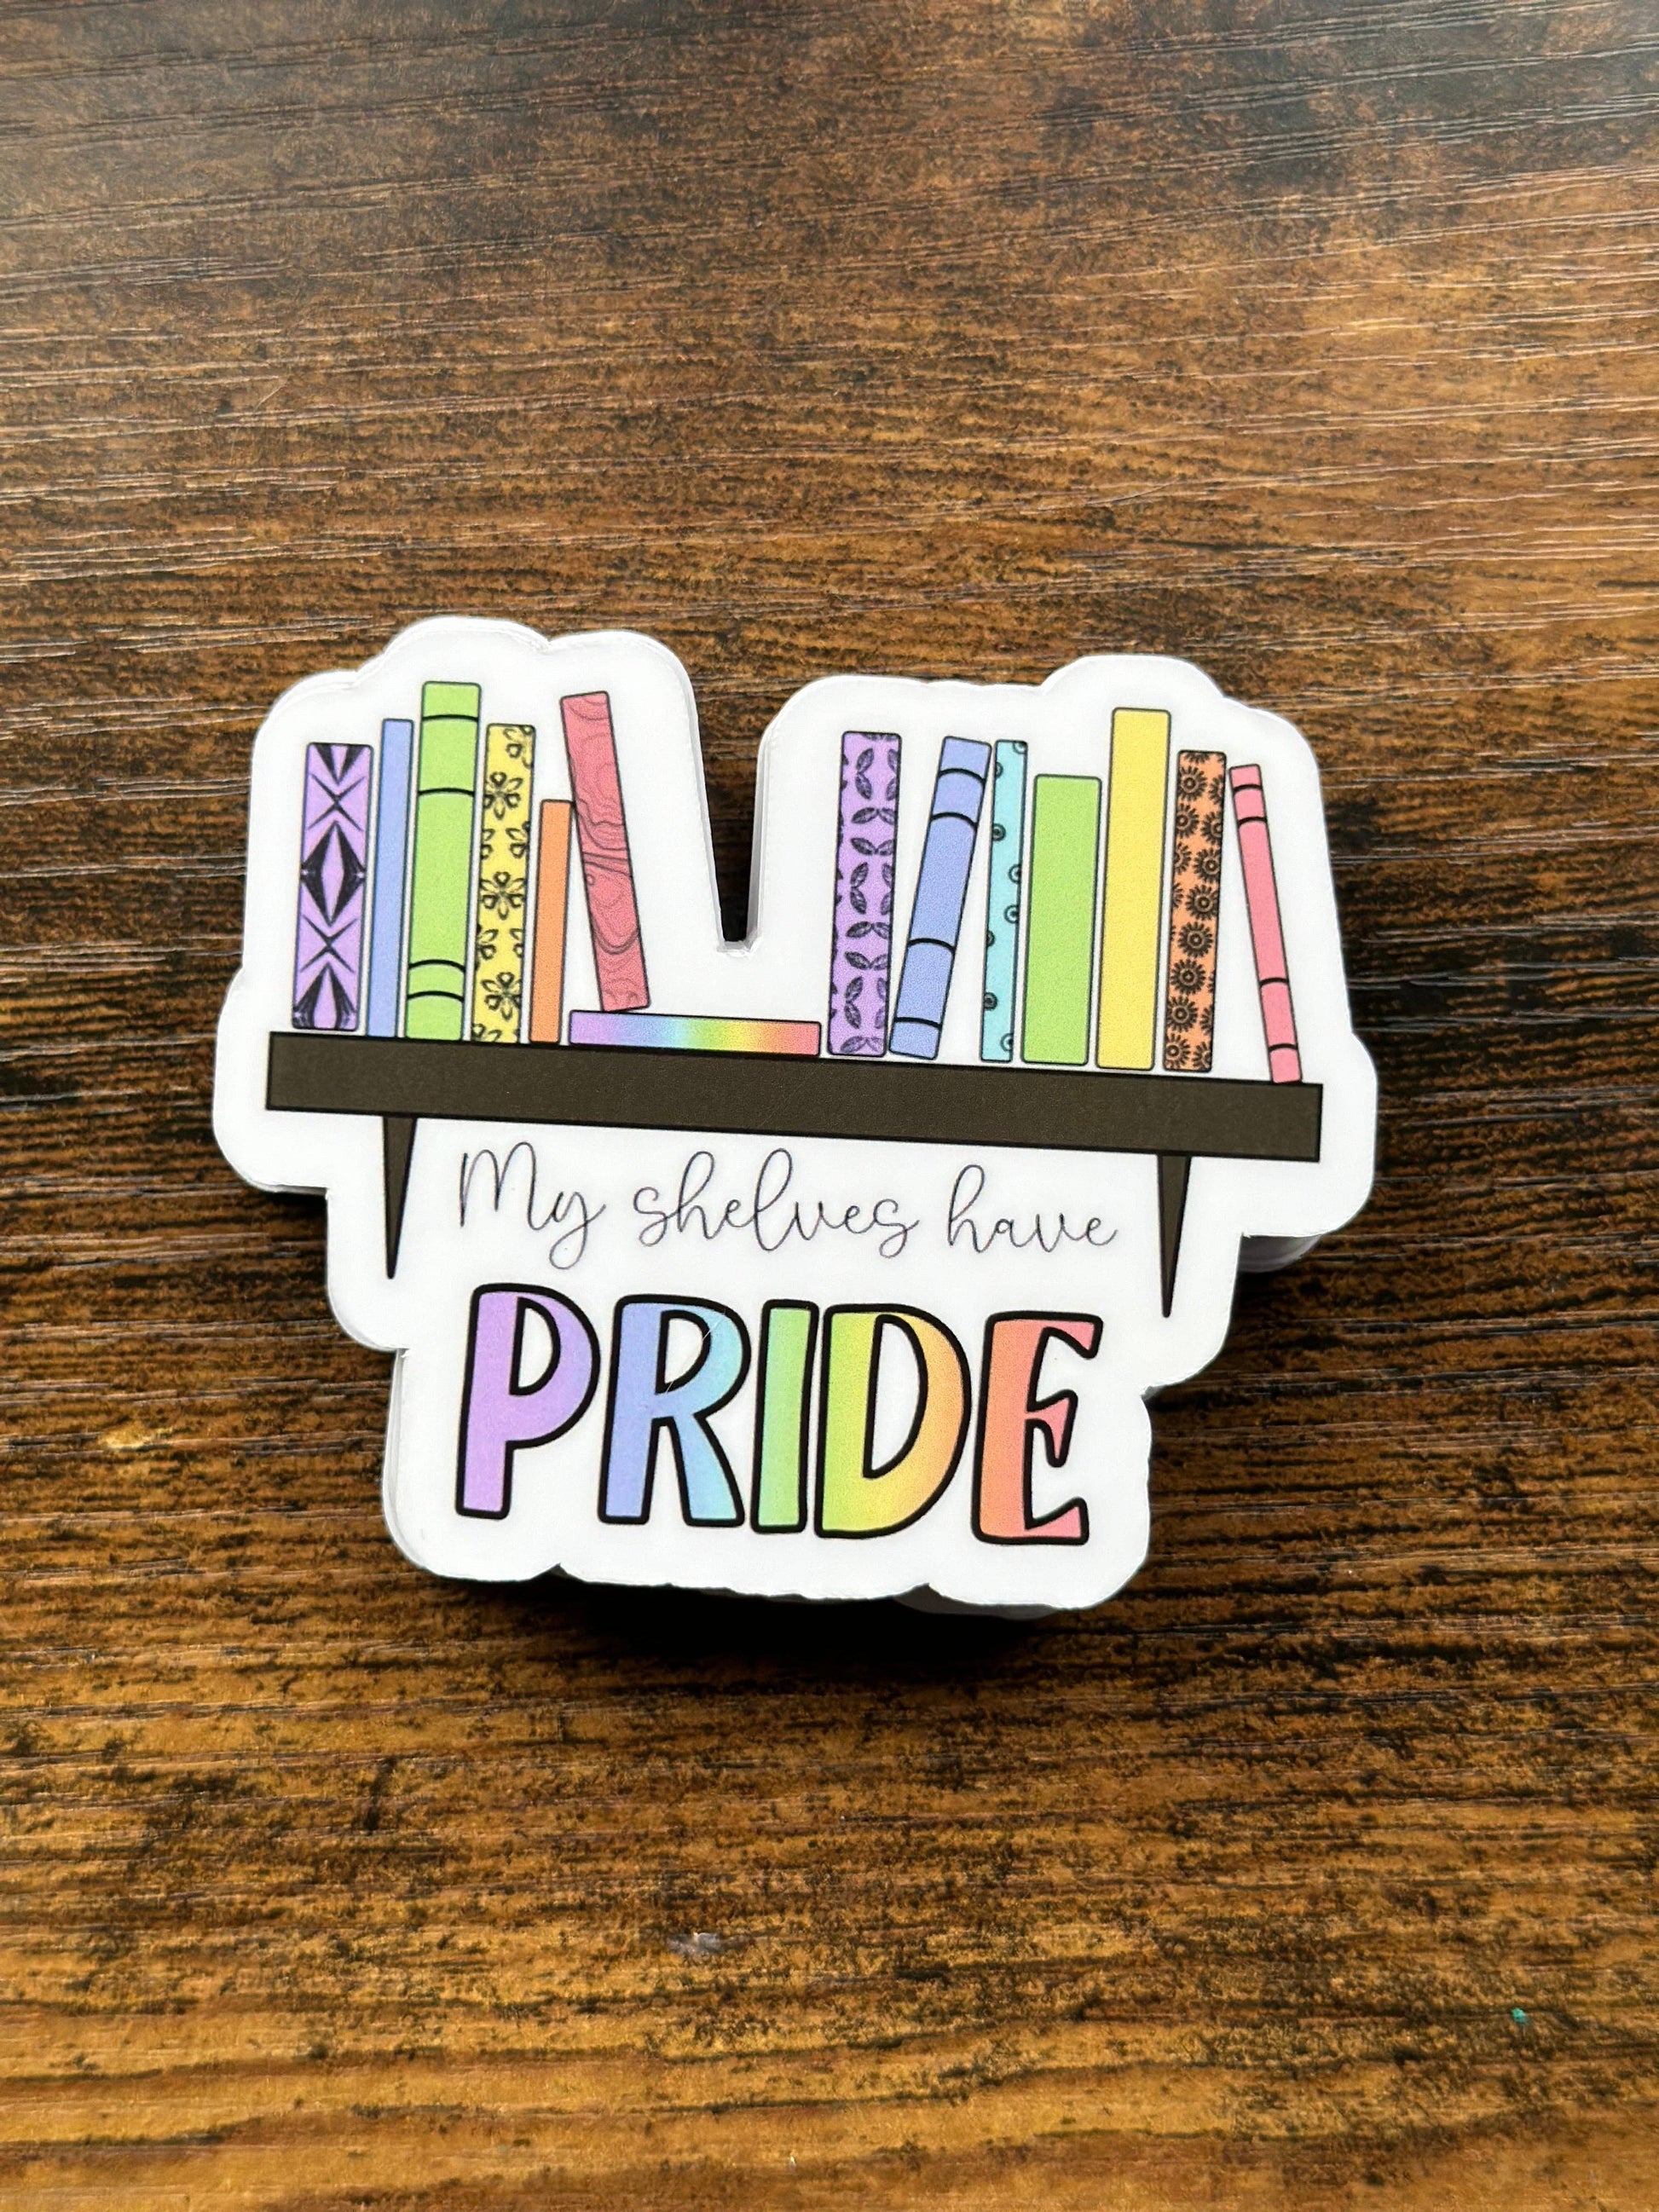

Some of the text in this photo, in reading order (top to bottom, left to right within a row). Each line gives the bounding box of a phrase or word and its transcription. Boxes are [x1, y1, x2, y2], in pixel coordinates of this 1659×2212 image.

[460, 1142, 1117, 1269] My shelves have
[454, 1283, 1104, 1546] PRIDE
